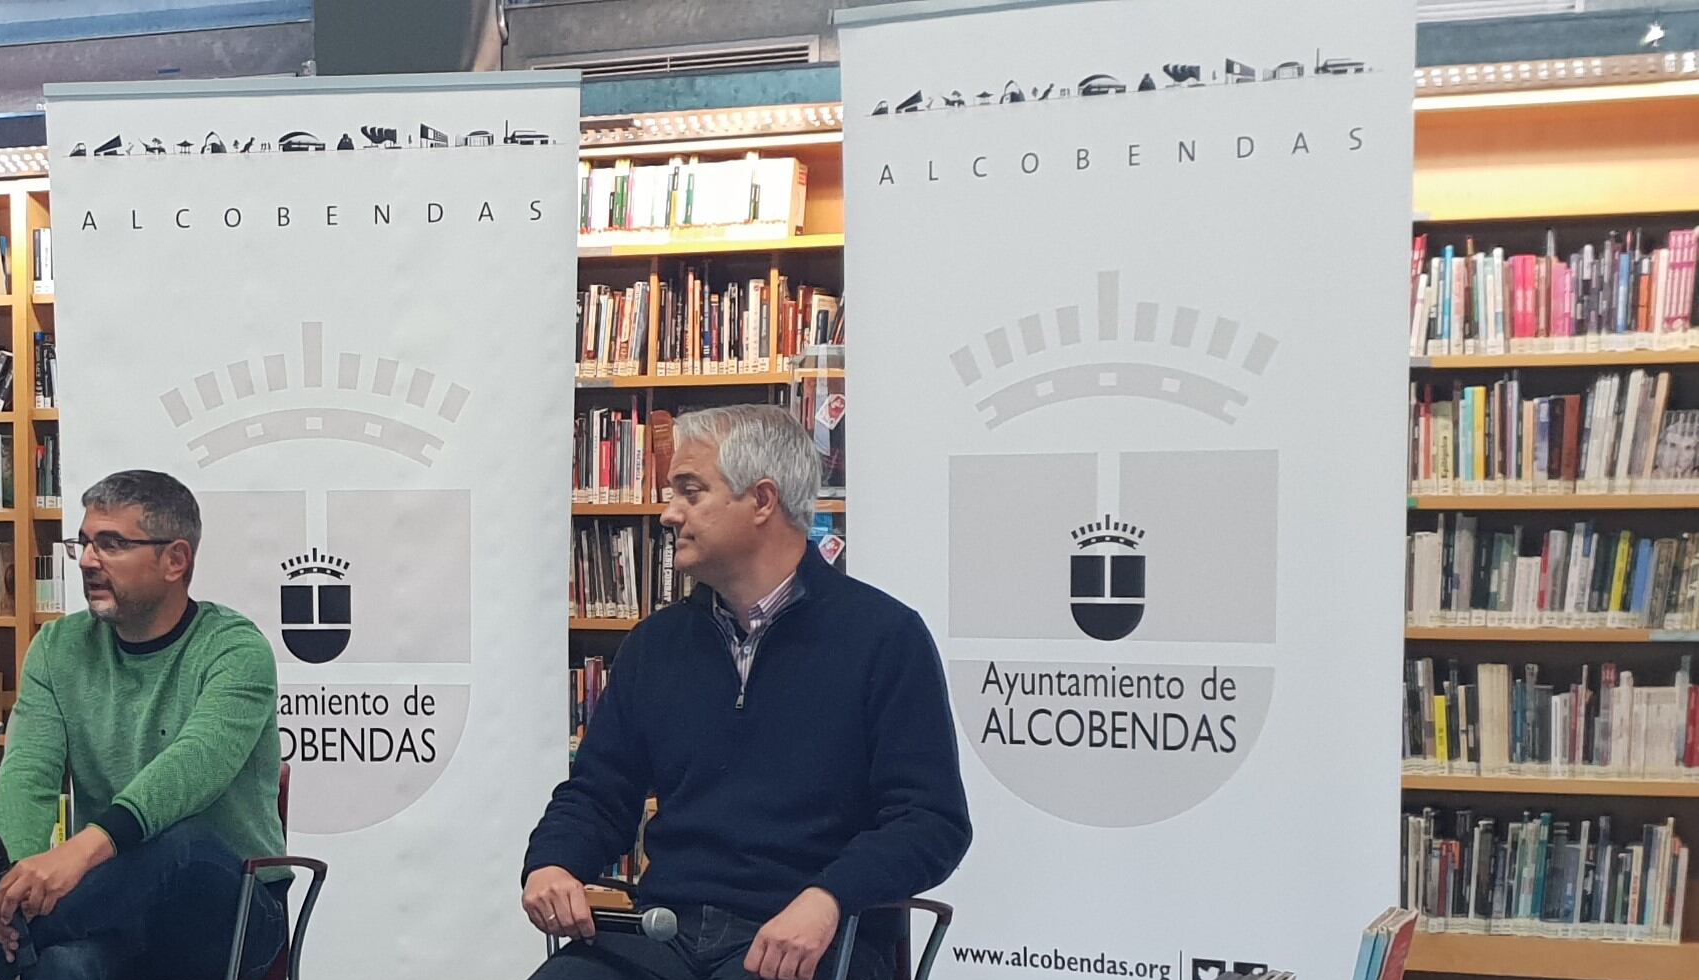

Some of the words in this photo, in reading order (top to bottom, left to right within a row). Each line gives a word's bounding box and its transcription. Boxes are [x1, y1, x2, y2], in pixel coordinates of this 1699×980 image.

[403, 684, 436, 716] de
[981, 661, 1185, 706] Ayuntamiento
[1200, 666, 1237, 701] de
[980, 707, 1237, 753] ALCOBENDAS
